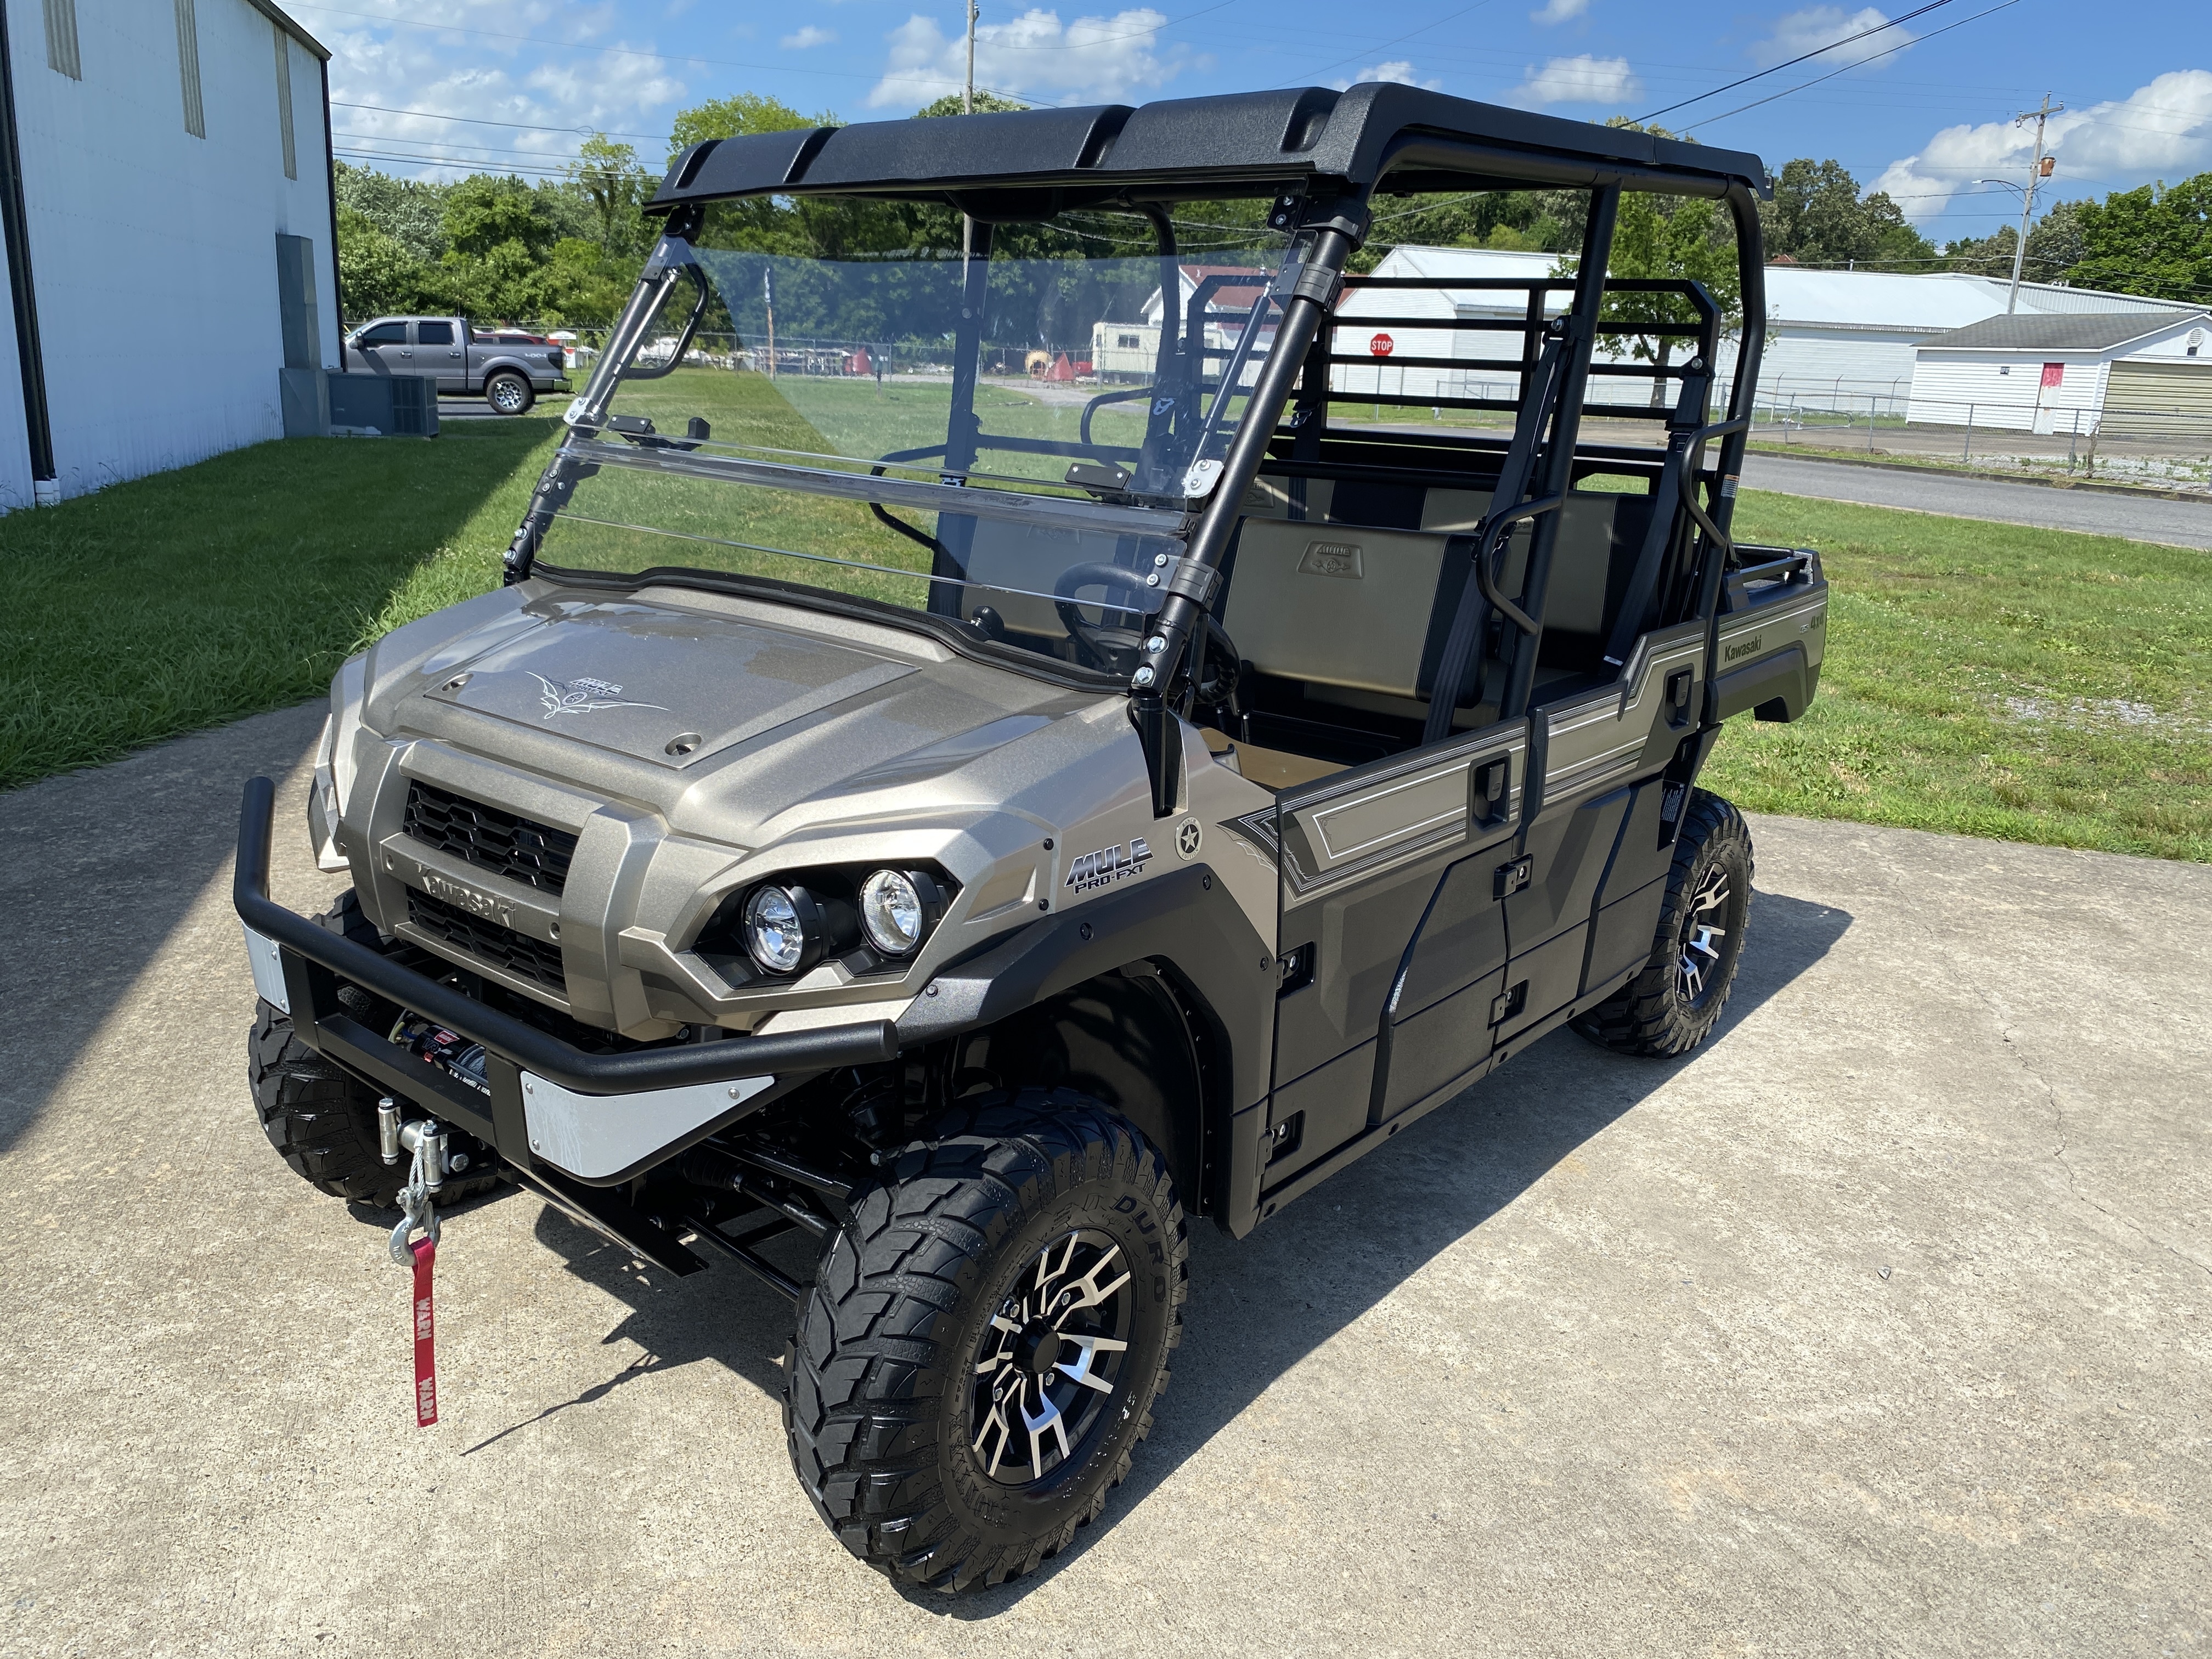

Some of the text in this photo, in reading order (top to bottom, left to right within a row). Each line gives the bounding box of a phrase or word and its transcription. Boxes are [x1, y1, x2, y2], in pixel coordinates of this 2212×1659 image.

[1371, 340, 1392, 351] STOP
[1316, 544, 1351, 556] MULE
[1724, 634, 1763, 663] Kawasaki
[569, 677, 623, 695] MULE
[1182, 818, 1197, 827] RANCH
[1064, 837, 1154, 887] MULE
[1181, 847, 1200, 860] EDITION
[1074, 862, 1147, 895] PRO-FXT
[414, 862, 517, 930] Kawasaki
[1110, 1193, 1166, 1302] DURO
[416, 1297, 432, 1341] WARN
[418, 1377, 435, 1421] WARN
